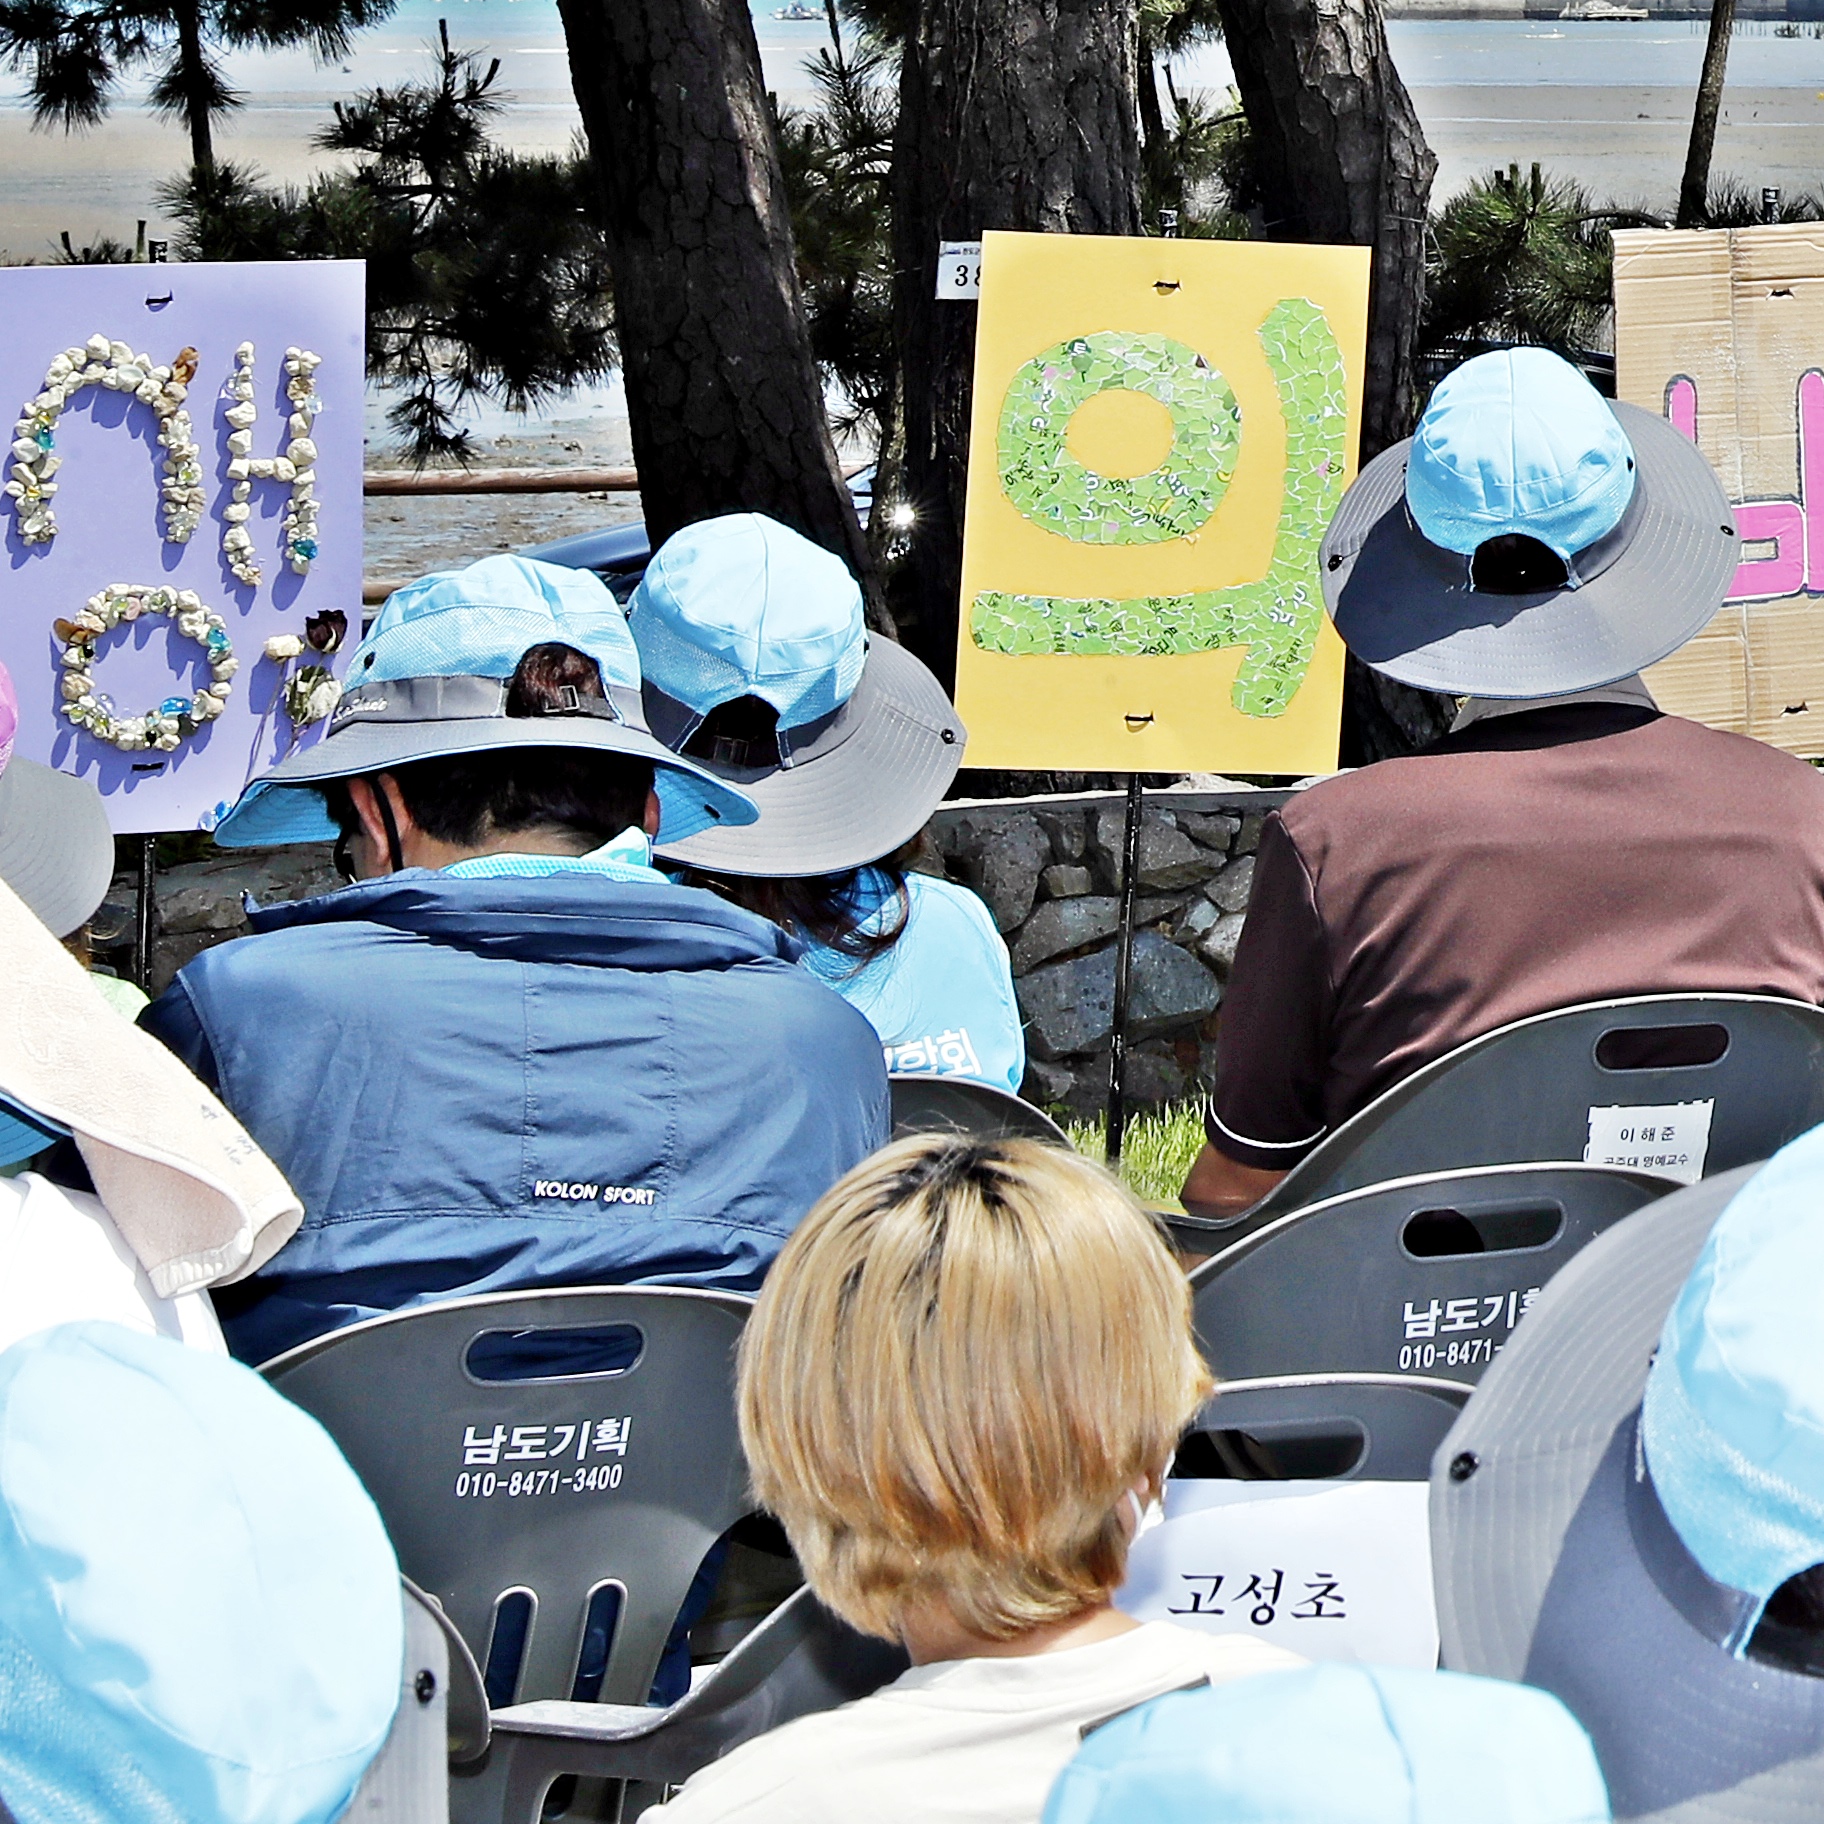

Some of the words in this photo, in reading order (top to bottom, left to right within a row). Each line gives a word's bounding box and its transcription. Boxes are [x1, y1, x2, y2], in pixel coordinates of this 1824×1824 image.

[533, 1179, 599, 1201] KOLON
[602, 1185, 656, 1206] SPORT
[462, 1415, 633, 1466] 남도기획
[455, 1463, 624, 1498] 010-8471-3400
[1166, 1567, 1348, 1627] 고성초
